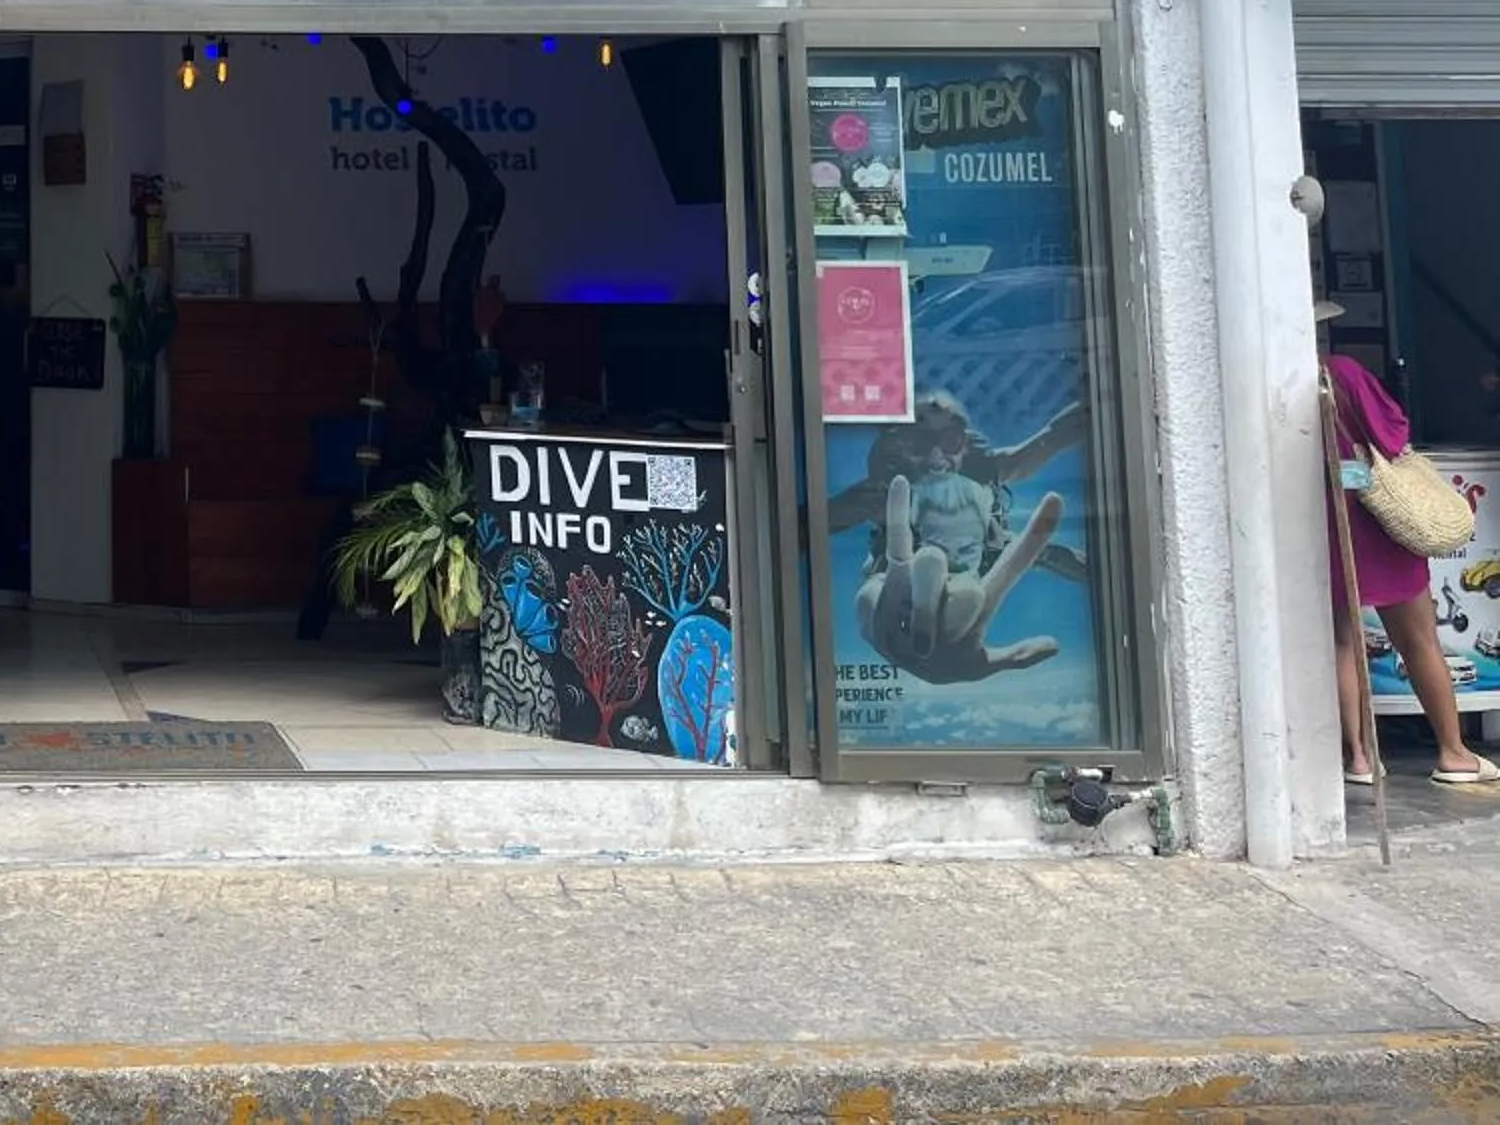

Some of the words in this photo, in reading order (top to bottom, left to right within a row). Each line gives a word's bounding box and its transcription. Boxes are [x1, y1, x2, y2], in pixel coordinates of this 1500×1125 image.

[329, 95, 536, 132] Hoelito
[330, 145, 409, 171] hotel
[944, 152, 1053, 184] COZUMEL
[489, 444, 649, 512] DIVE
[510, 511, 611, 554] INFO
[836, 664, 855, 680] HE
[860, 664, 899, 681] BEST
[836, 687, 904, 702] PERIENCE
[867, 709, 889, 724] LIF
